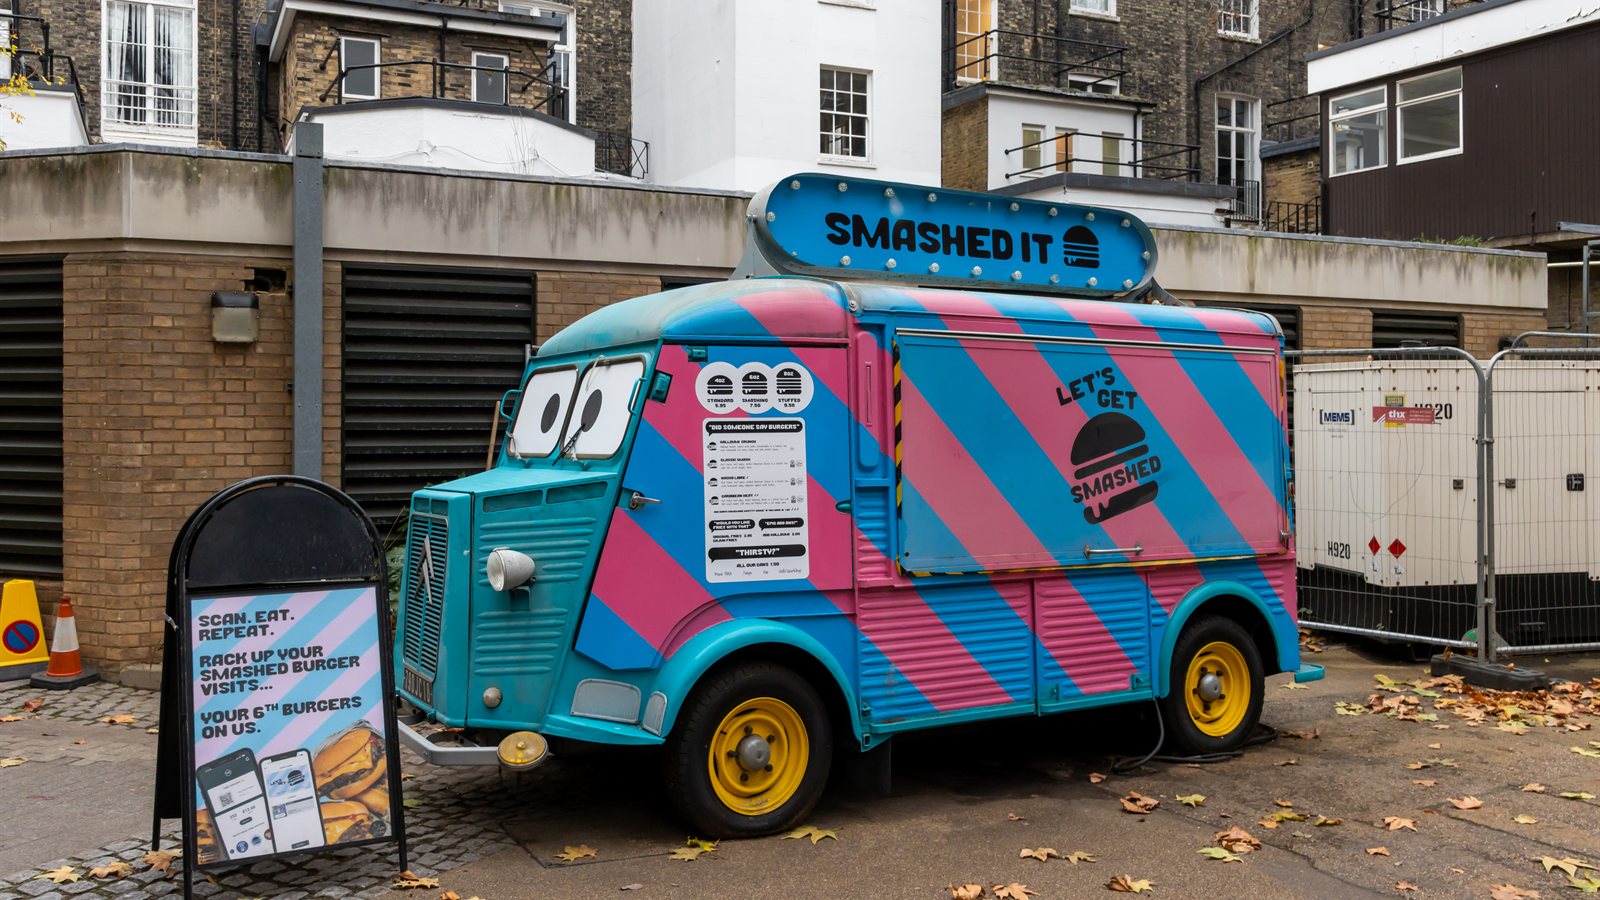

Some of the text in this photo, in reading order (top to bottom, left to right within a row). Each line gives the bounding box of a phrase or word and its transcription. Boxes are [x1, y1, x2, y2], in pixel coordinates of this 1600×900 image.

[825, 212, 1053, 264] SMASHED IT
[1056, 366, 1115, 406] LET'S
[1097, 389, 1137, 410] GET
[1070, 455, 1162, 504] SMASHED
[735, 548, 780, 556] "THIRSTY?"
[1327, 541, 1351, 560] H920
[199, 609, 295, 627] SCAN. EAT.
[199, 624, 274, 641] REPEAT.
[199, 645, 324, 668] RACK UP YOUR
[200, 655, 360, 682] SMASHED BURGER
[200, 679, 273, 696] VISITS...
[200, 708, 249, 725] YOUR
[282, 696, 362, 716] BURGERS
[201, 721, 261, 739] ON US.
